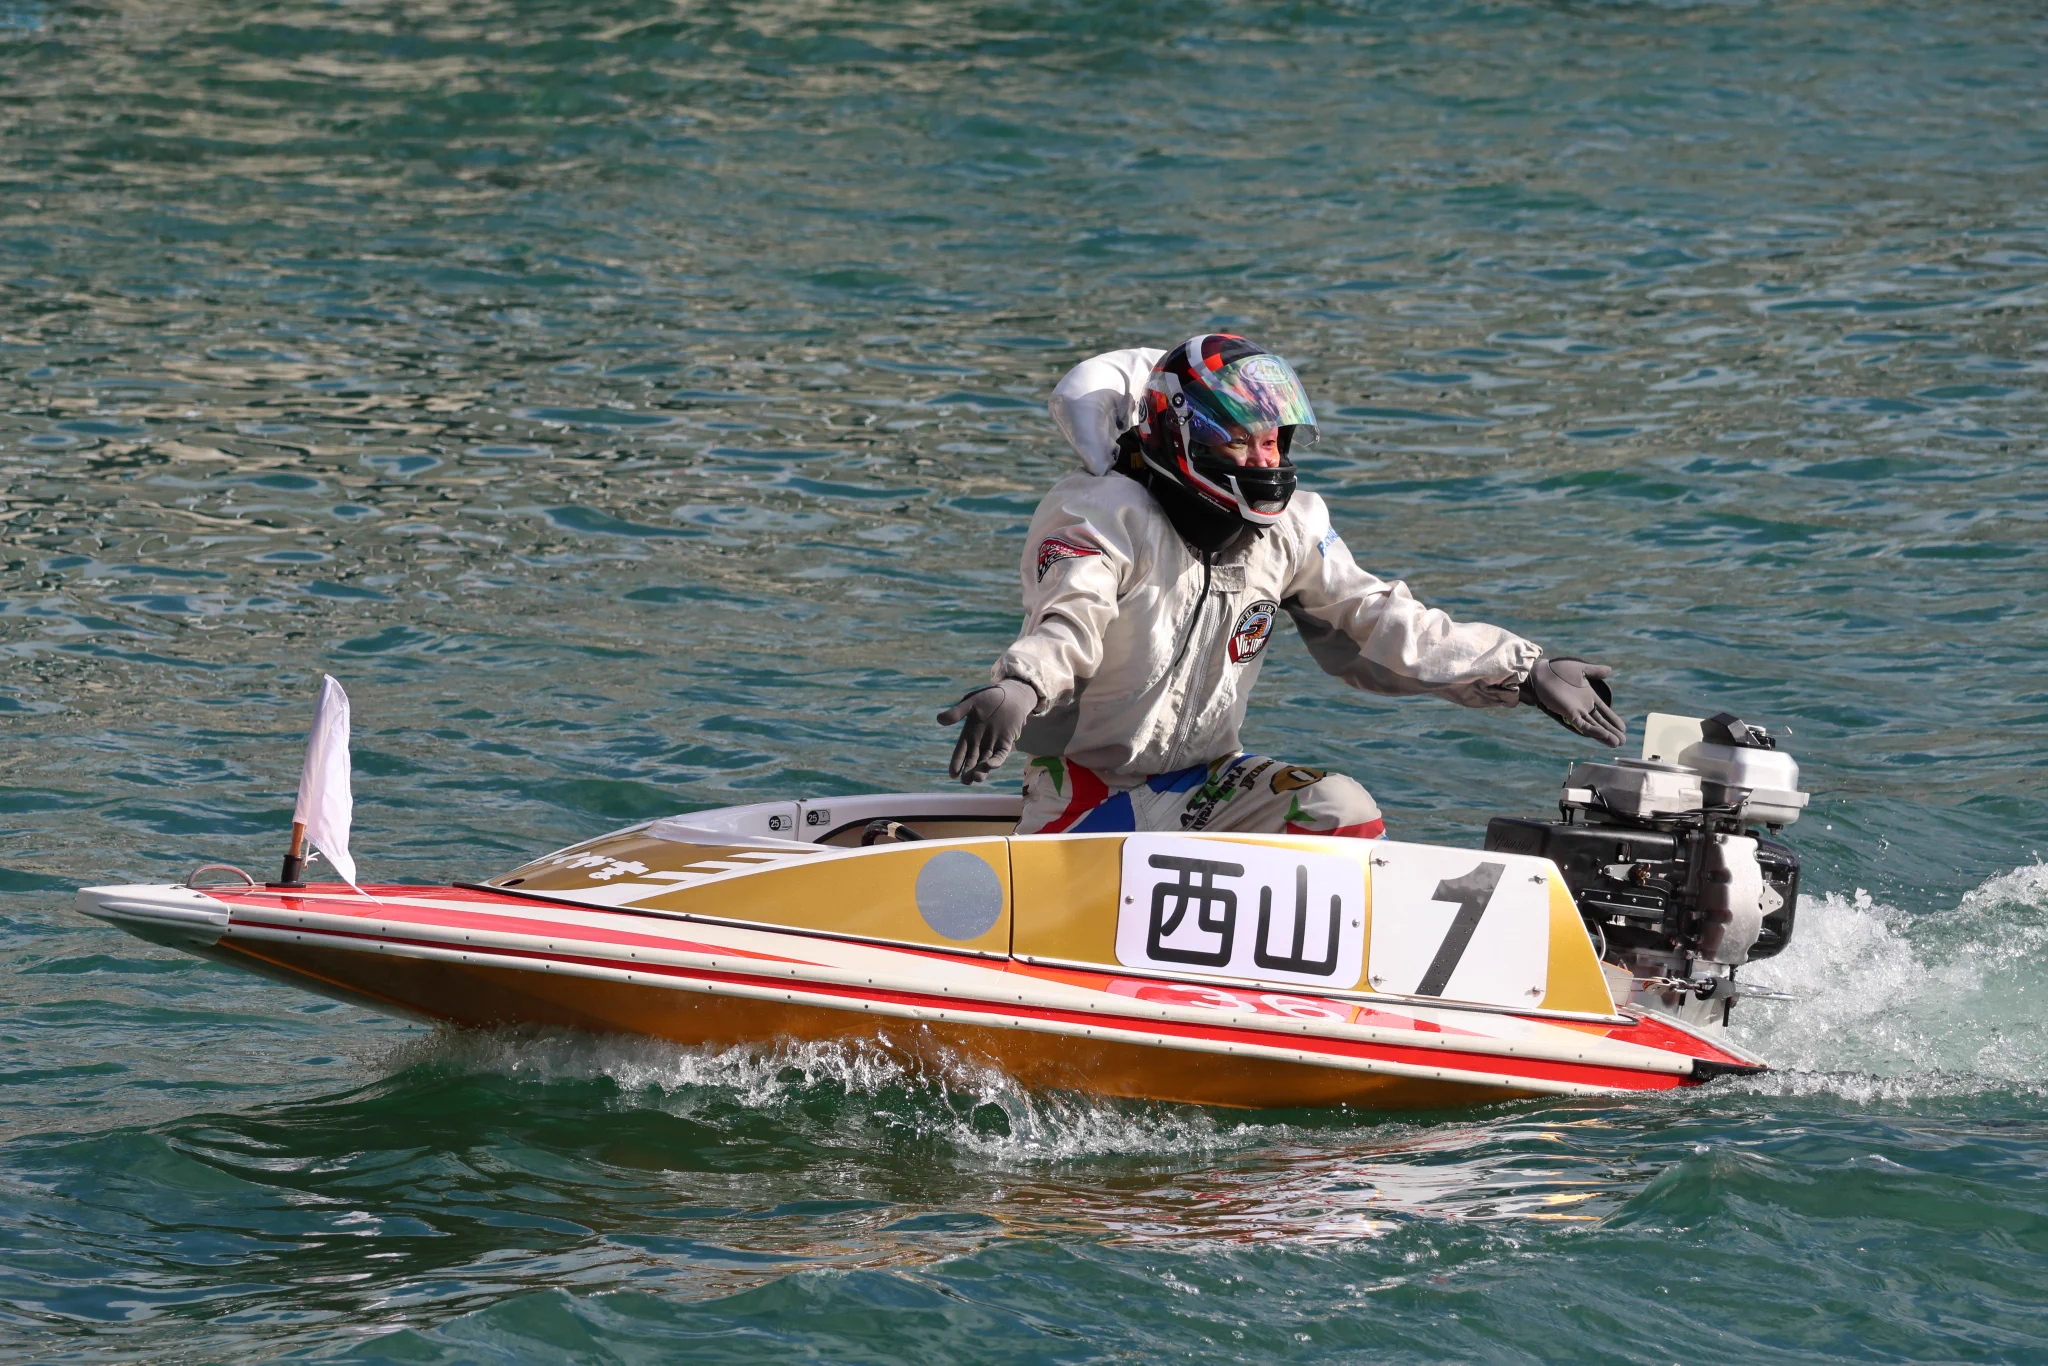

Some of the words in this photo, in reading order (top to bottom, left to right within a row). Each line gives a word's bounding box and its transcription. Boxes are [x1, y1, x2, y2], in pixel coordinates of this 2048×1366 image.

[770, 819, 780, 828] 25
[809, 814, 818, 823] 25
[1145, 853, 1342, 978] 西山
[1414, 860, 1507, 998] 1
[1166, 984, 1347, 1024] 36
